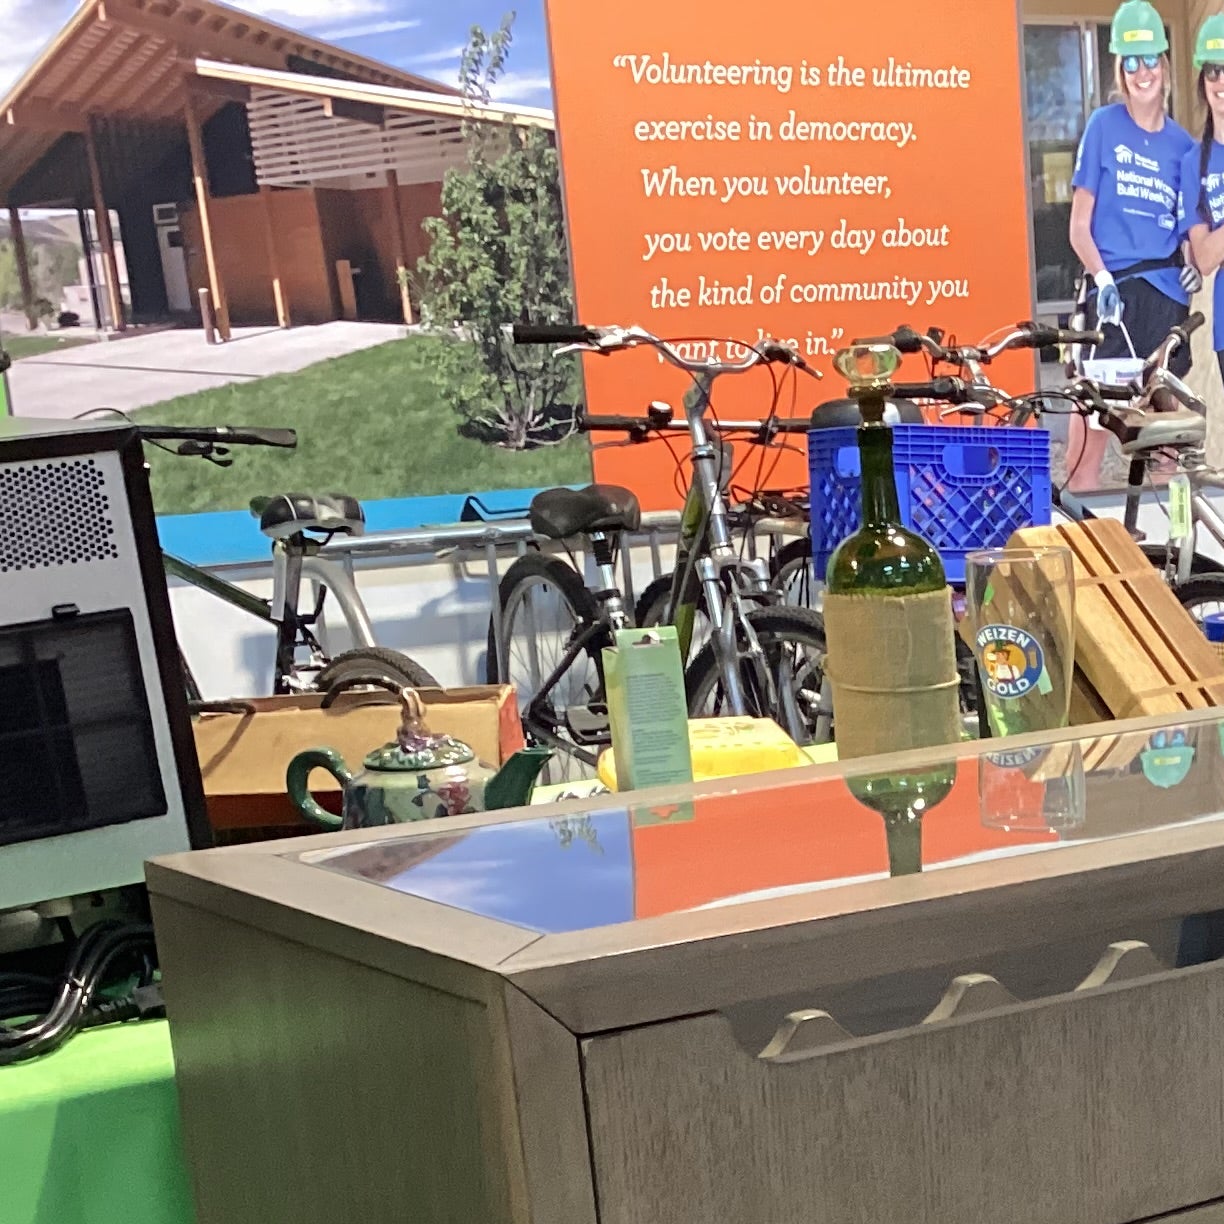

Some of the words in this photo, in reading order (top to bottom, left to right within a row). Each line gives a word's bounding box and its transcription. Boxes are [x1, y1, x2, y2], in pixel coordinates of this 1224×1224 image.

[613, 52, 792, 92] “Volunteering
[800, 60, 820, 85] is
[828, 56, 865, 86] the
[872, 58, 970, 88] ultimate
[635, 115, 741, 140] exercise
[749, 115, 772, 140] in
[780, 110, 916, 147] democracy.
[641, 166, 716, 196] When
[721, 177, 768, 202] you
[775, 165, 890, 197] volunteer,
[1117, 170, 1153, 187] National
[1117, 183, 1140, 198] Build
[643, 234, 691, 260] you
[698, 228, 750, 250] vote
[758, 231, 824, 255] every
[831, 219, 875, 254] day
[882, 218, 949, 247] about
[651, 278, 690, 308] the
[699, 275, 753, 305] kind
[760, 274, 786, 304] of
[791, 276, 922, 305] community
[927, 278, 969, 304] you
[977, 628, 1031, 648] WEIZEN
[986, 677, 1031, 695] GOLD
